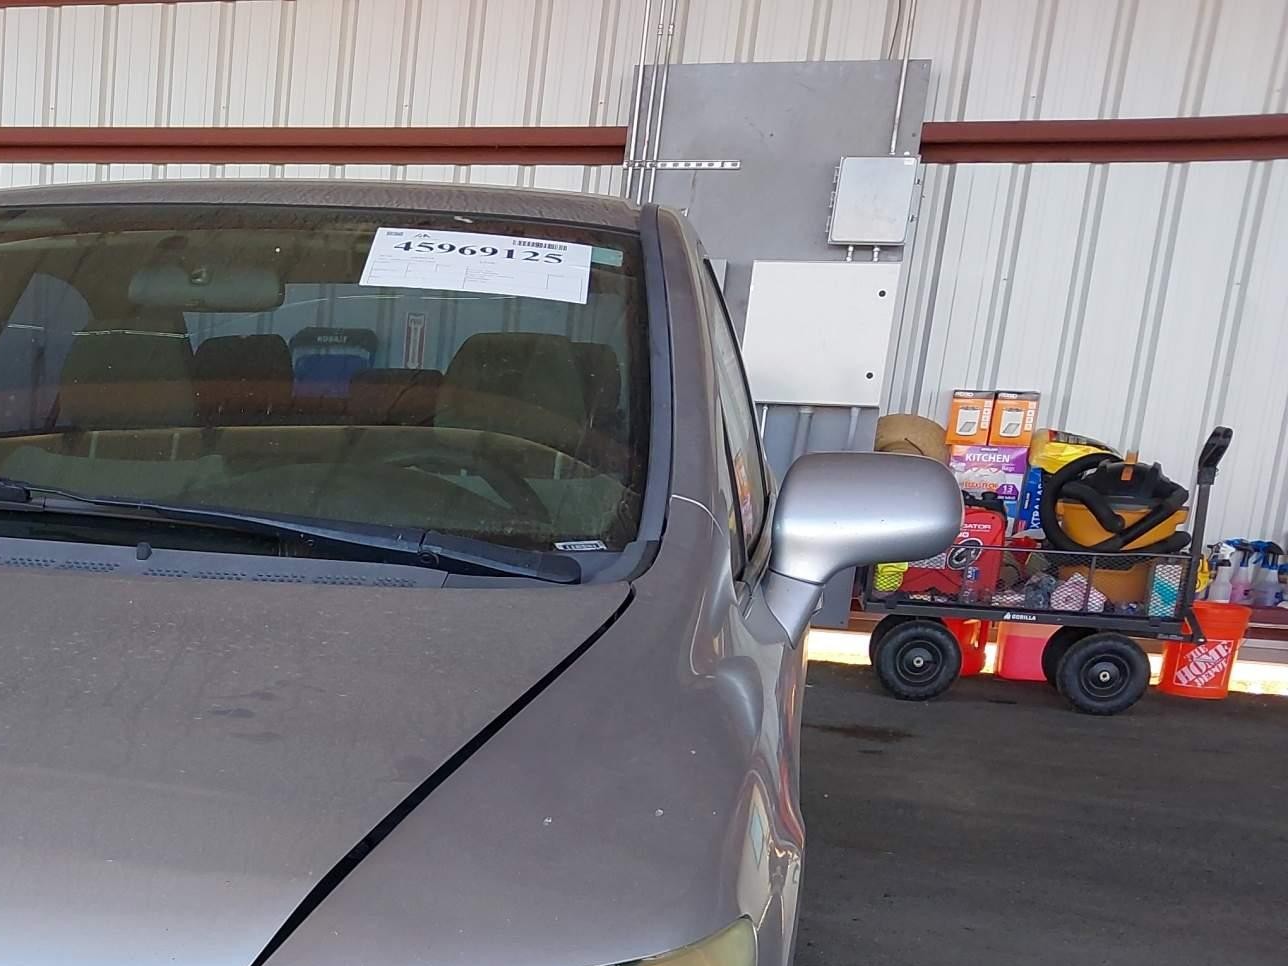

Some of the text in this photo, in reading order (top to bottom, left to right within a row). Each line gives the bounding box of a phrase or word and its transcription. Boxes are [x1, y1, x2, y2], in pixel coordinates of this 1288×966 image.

[394, 240, 564, 265] 45969125
[965, 453, 1010, 463] KITCHEN
[1002, 485, 1013, 494] 13
[1175, 640, 1230, 685] HOME
[1184, 644, 1209, 661] THE
[1194, 658, 1228, 688] DEPOT
